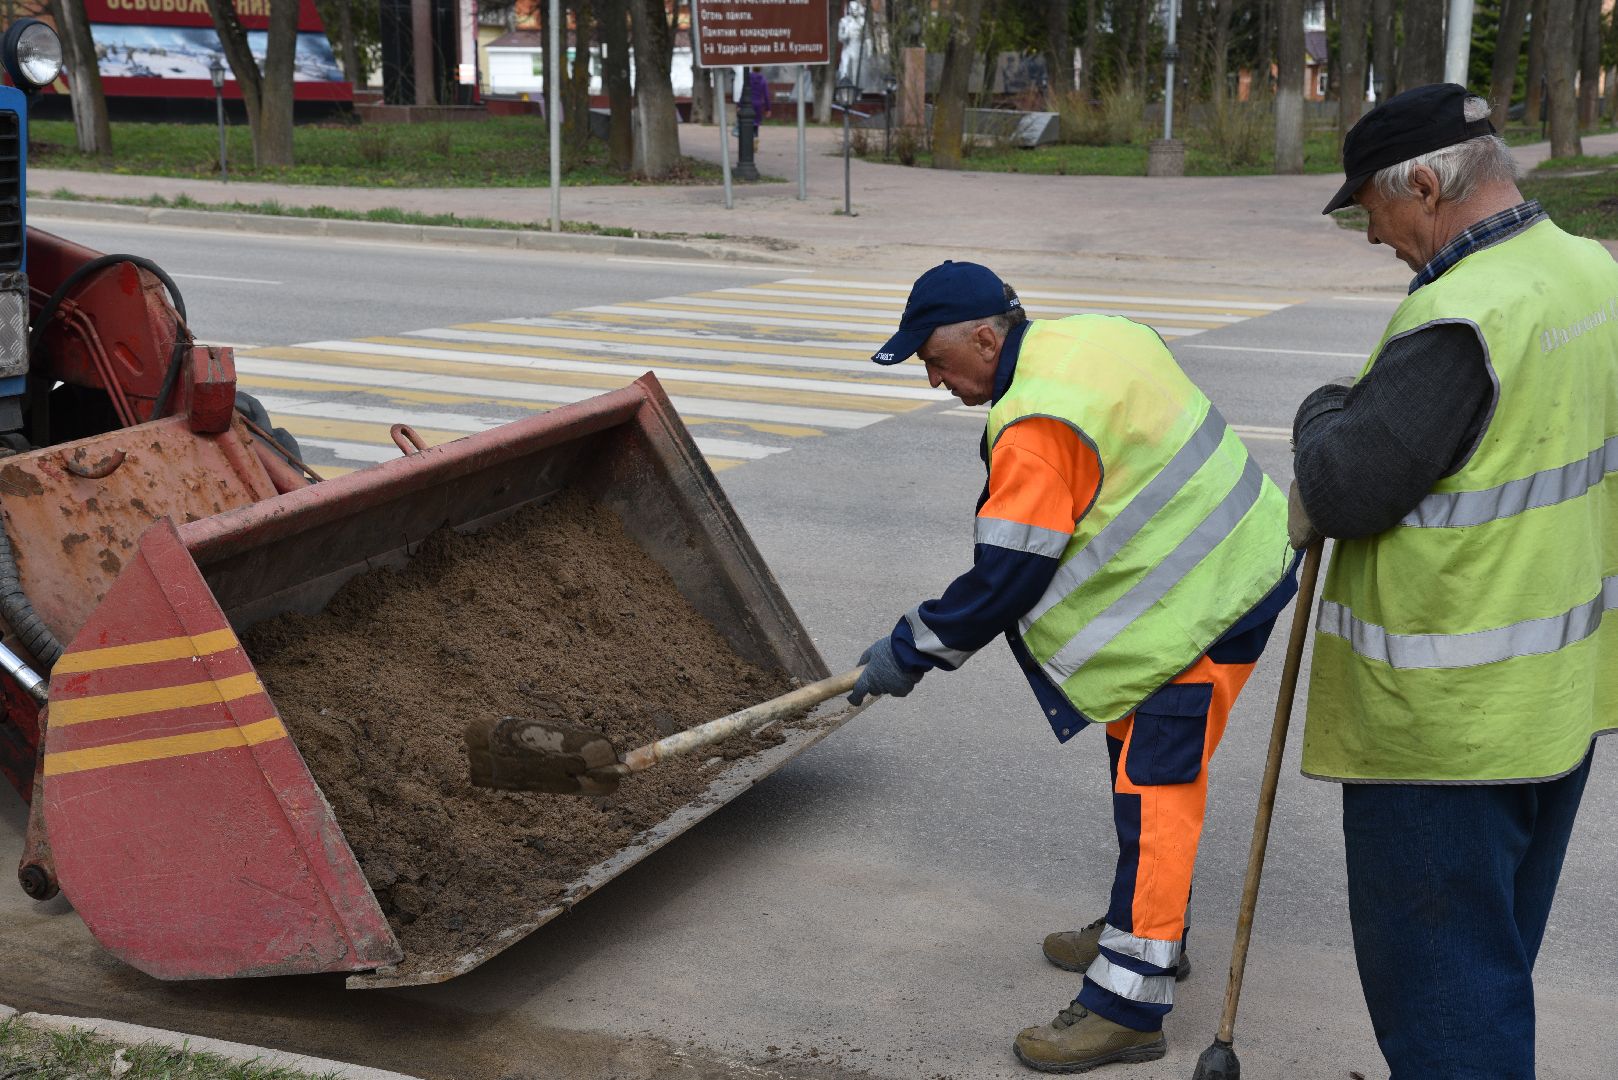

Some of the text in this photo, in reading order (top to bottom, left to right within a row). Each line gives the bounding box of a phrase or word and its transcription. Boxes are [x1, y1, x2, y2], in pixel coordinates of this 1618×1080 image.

[701, 9, 723, 20] Огонь
[702, 26, 791, 39] Памятник командующему
[704, 43, 714, 54] 1-й
[717, 43, 747, 55] Ударной
[750, 44, 771, 55] армии
[789, 41, 823, 55] Кузнецову
[875, 352, 895, 361] SWAT
